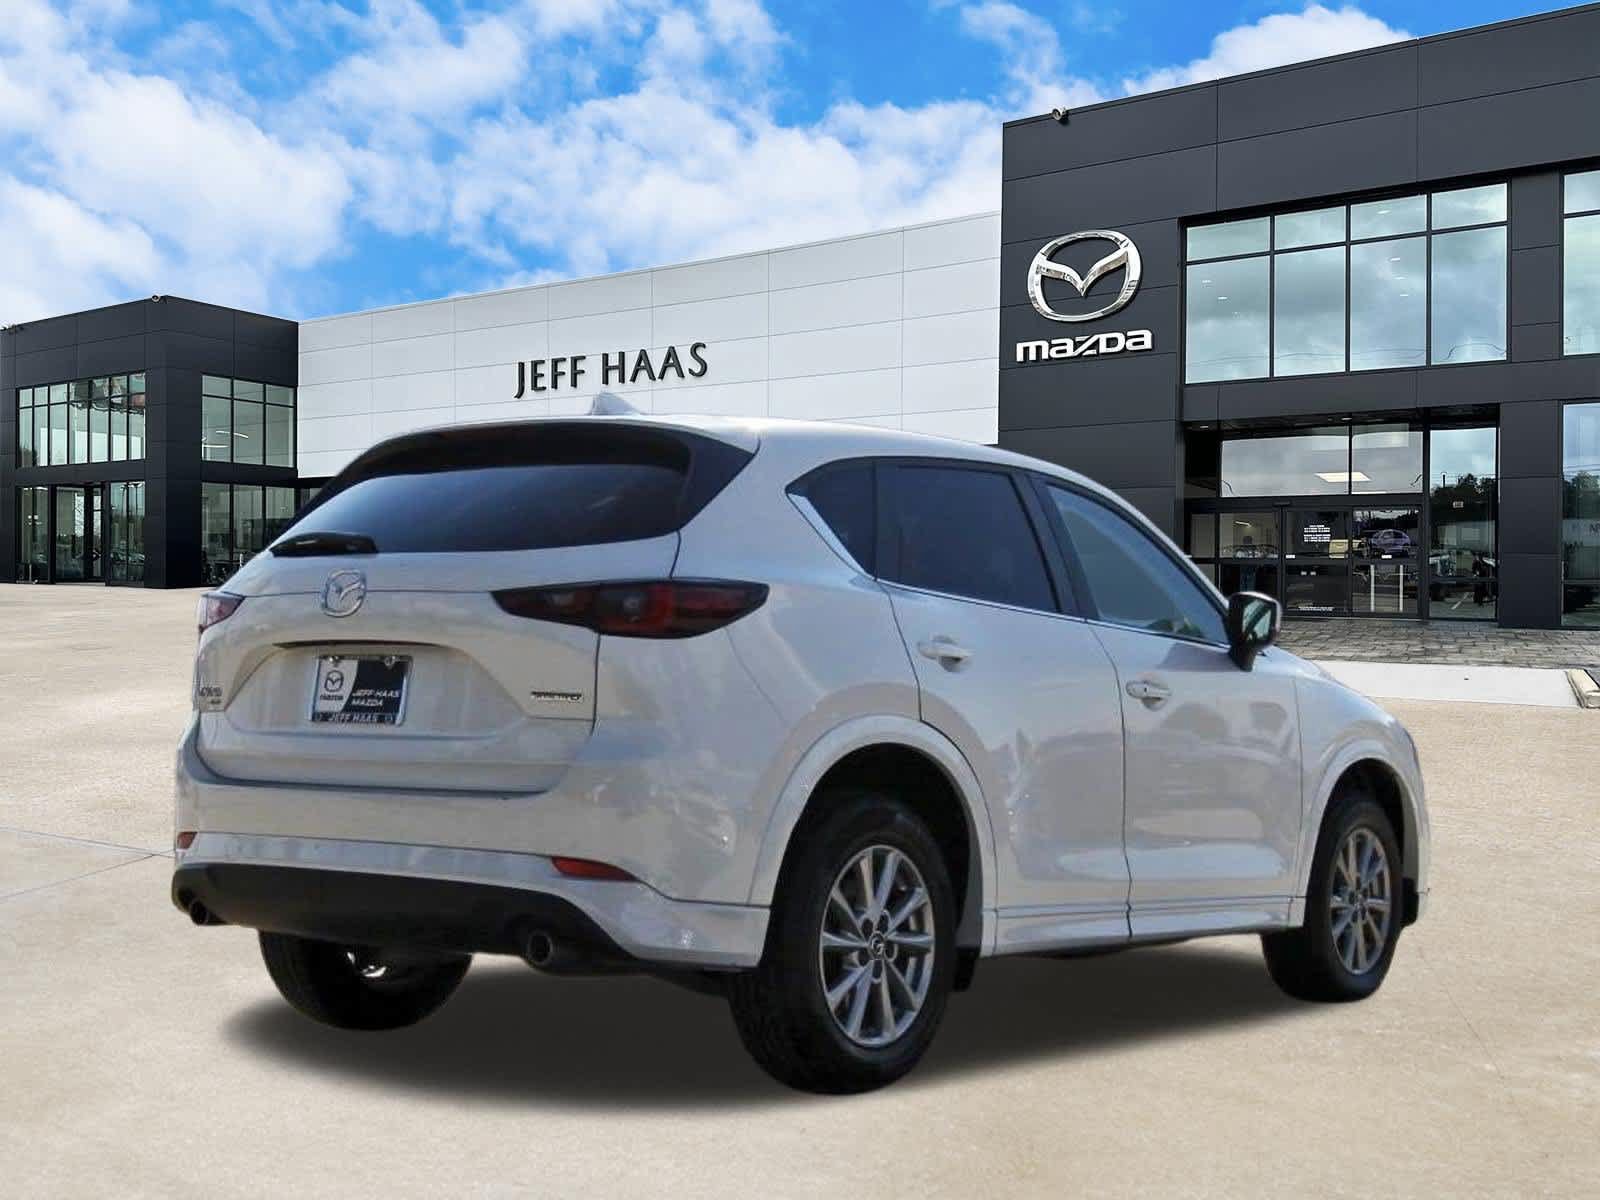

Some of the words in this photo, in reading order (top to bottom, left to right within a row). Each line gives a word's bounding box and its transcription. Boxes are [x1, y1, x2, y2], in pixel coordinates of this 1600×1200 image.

[514, 355, 586, 399] JEFF
[601, 342, 708, 385] HAAS
[352, 689, 375, 697] JEFF
[376, 689, 401, 698] HAAS
[351, 698, 384, 706] MAZDA
[352, 713, 379, 722] HAAS
